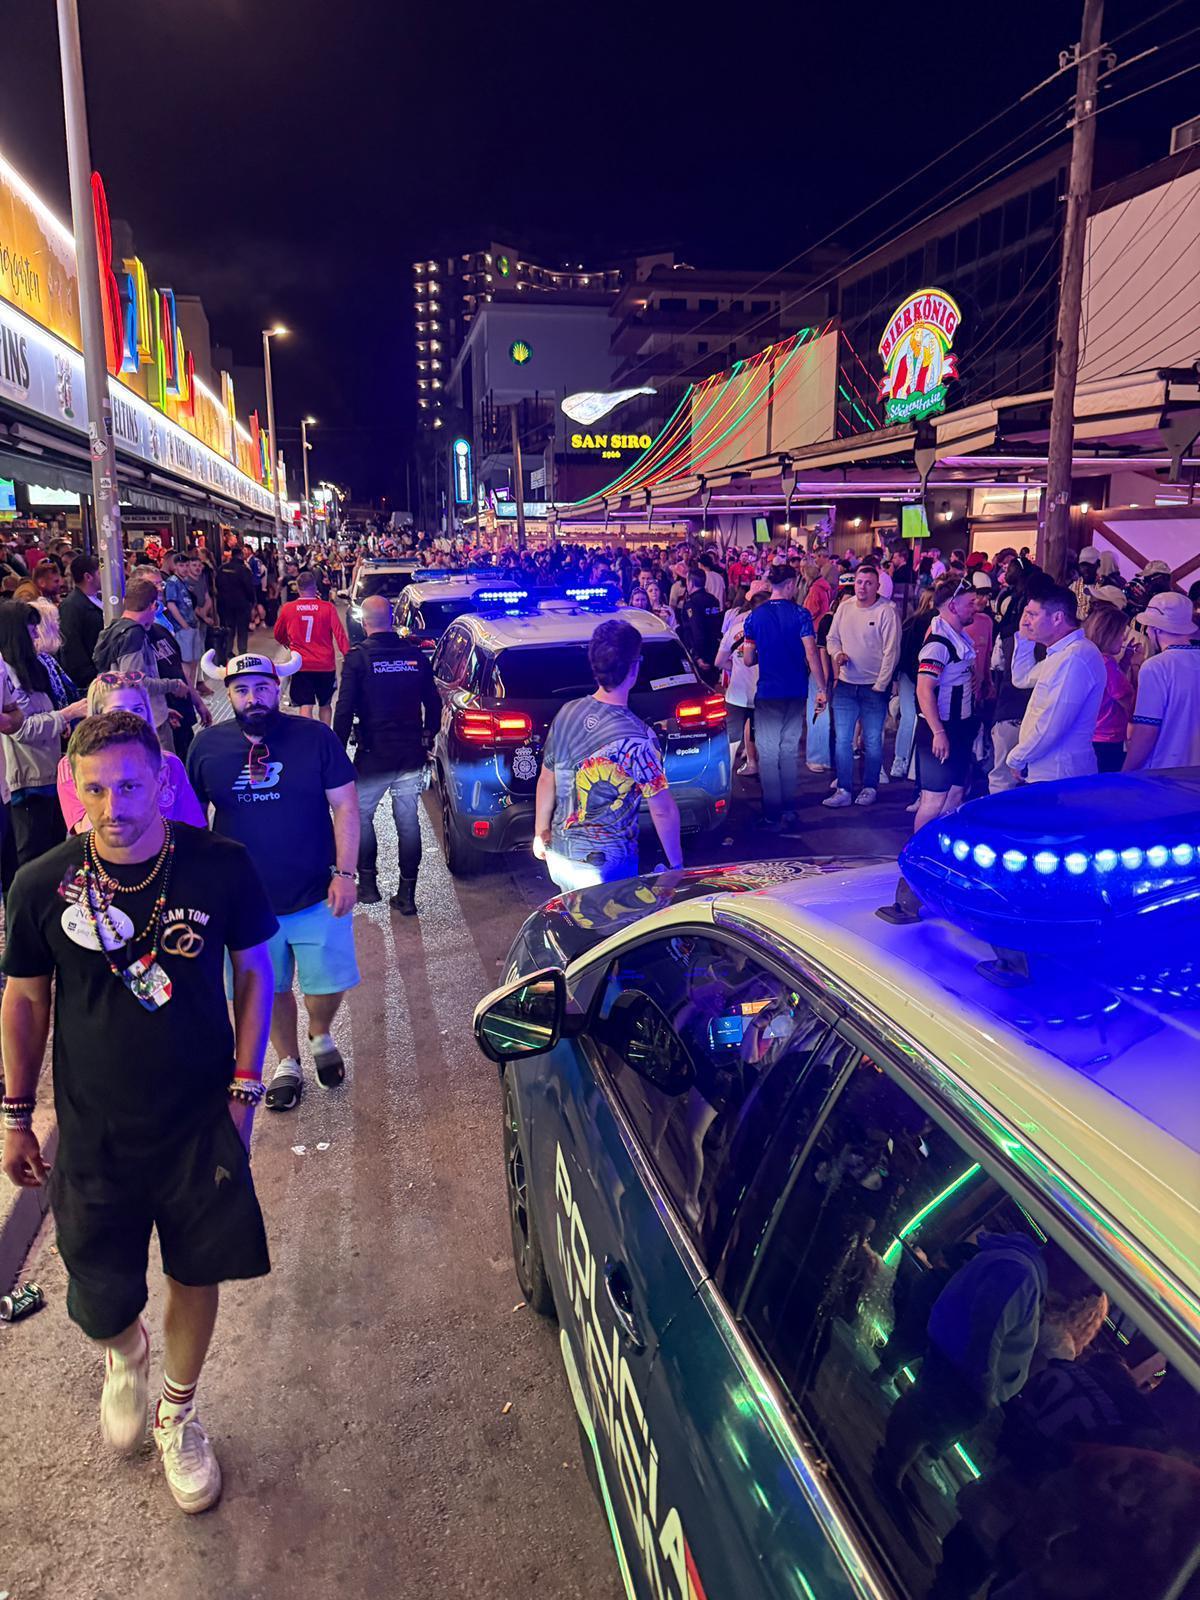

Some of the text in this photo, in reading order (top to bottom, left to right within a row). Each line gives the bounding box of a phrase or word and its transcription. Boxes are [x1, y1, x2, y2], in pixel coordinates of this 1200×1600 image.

[881, 294, 957, 358] BIERKÖNIG
[110, 394, 139, 443] ELTINS
[571, 434, 652, 449] SAN SIRO
[296, 603, 319, 611] RONALDO
[301, 615, 314, 643] 7
[373, 660, 408, 668] POLICIA
[374, 666, 419, 674] NACIONAL
[676, 747, 700, 756] @policia
[237, 791, 280, 803] FC Porto
[161, 908, 210, 927] EAM TOM
